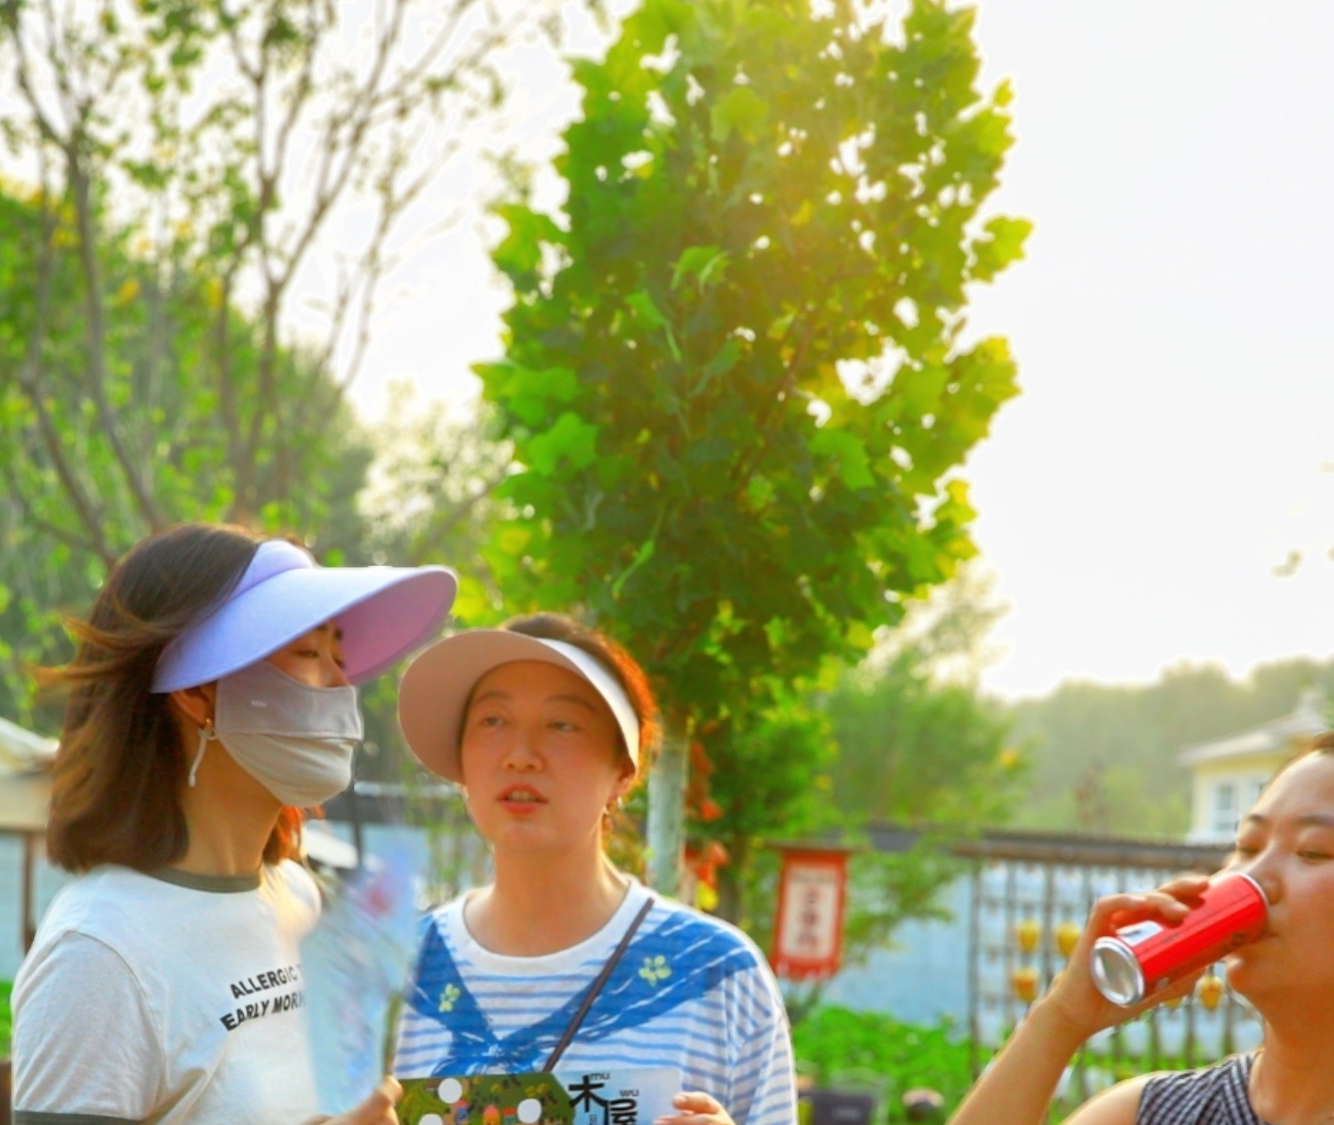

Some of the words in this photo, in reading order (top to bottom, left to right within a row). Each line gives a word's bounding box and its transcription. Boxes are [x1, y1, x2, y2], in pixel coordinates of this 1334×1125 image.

[230, 965, 298, 999] ALLERGIC
[220, 1000, 269, 1031] EARLY
[620, 1089, 639, 1097] wu
